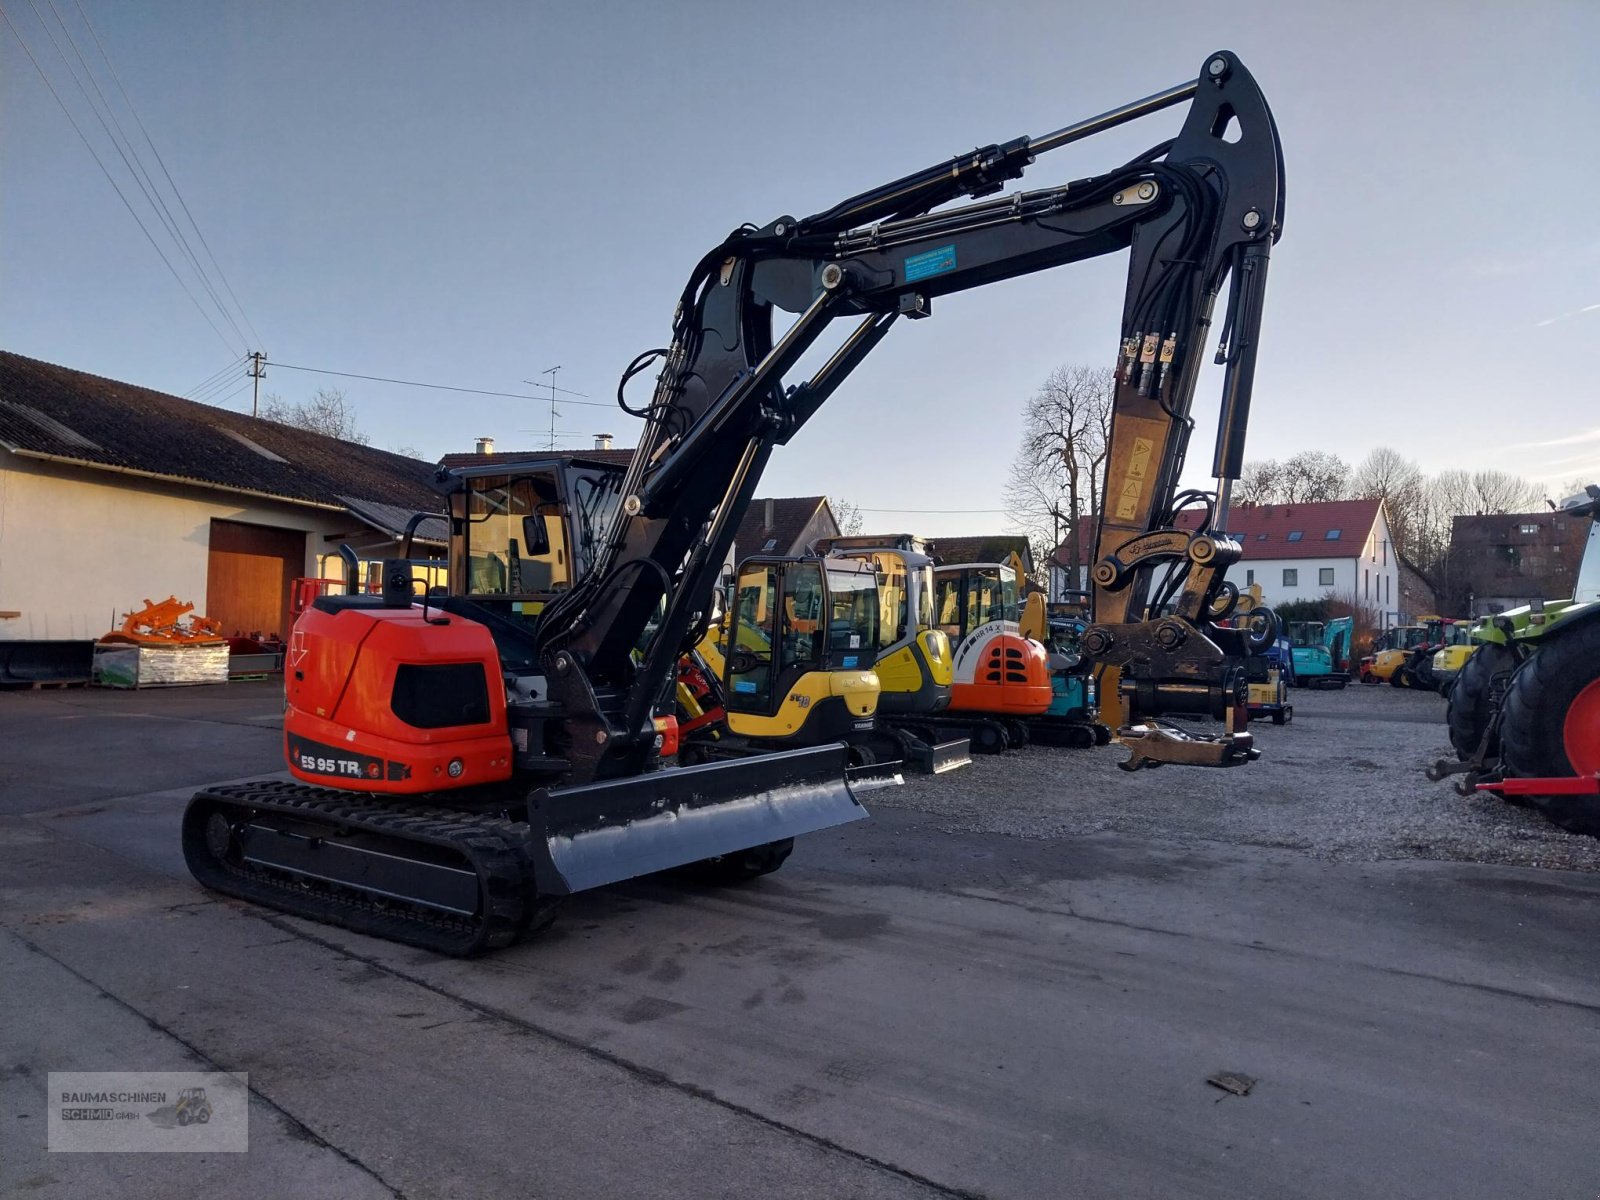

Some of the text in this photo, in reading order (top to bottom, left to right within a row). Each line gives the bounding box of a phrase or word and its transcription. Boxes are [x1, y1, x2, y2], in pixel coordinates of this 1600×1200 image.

[975, 629, 986, 639] HR
[985, 625, 994, 633] 14
[301, 755, 359, 774] ES 95 TR
